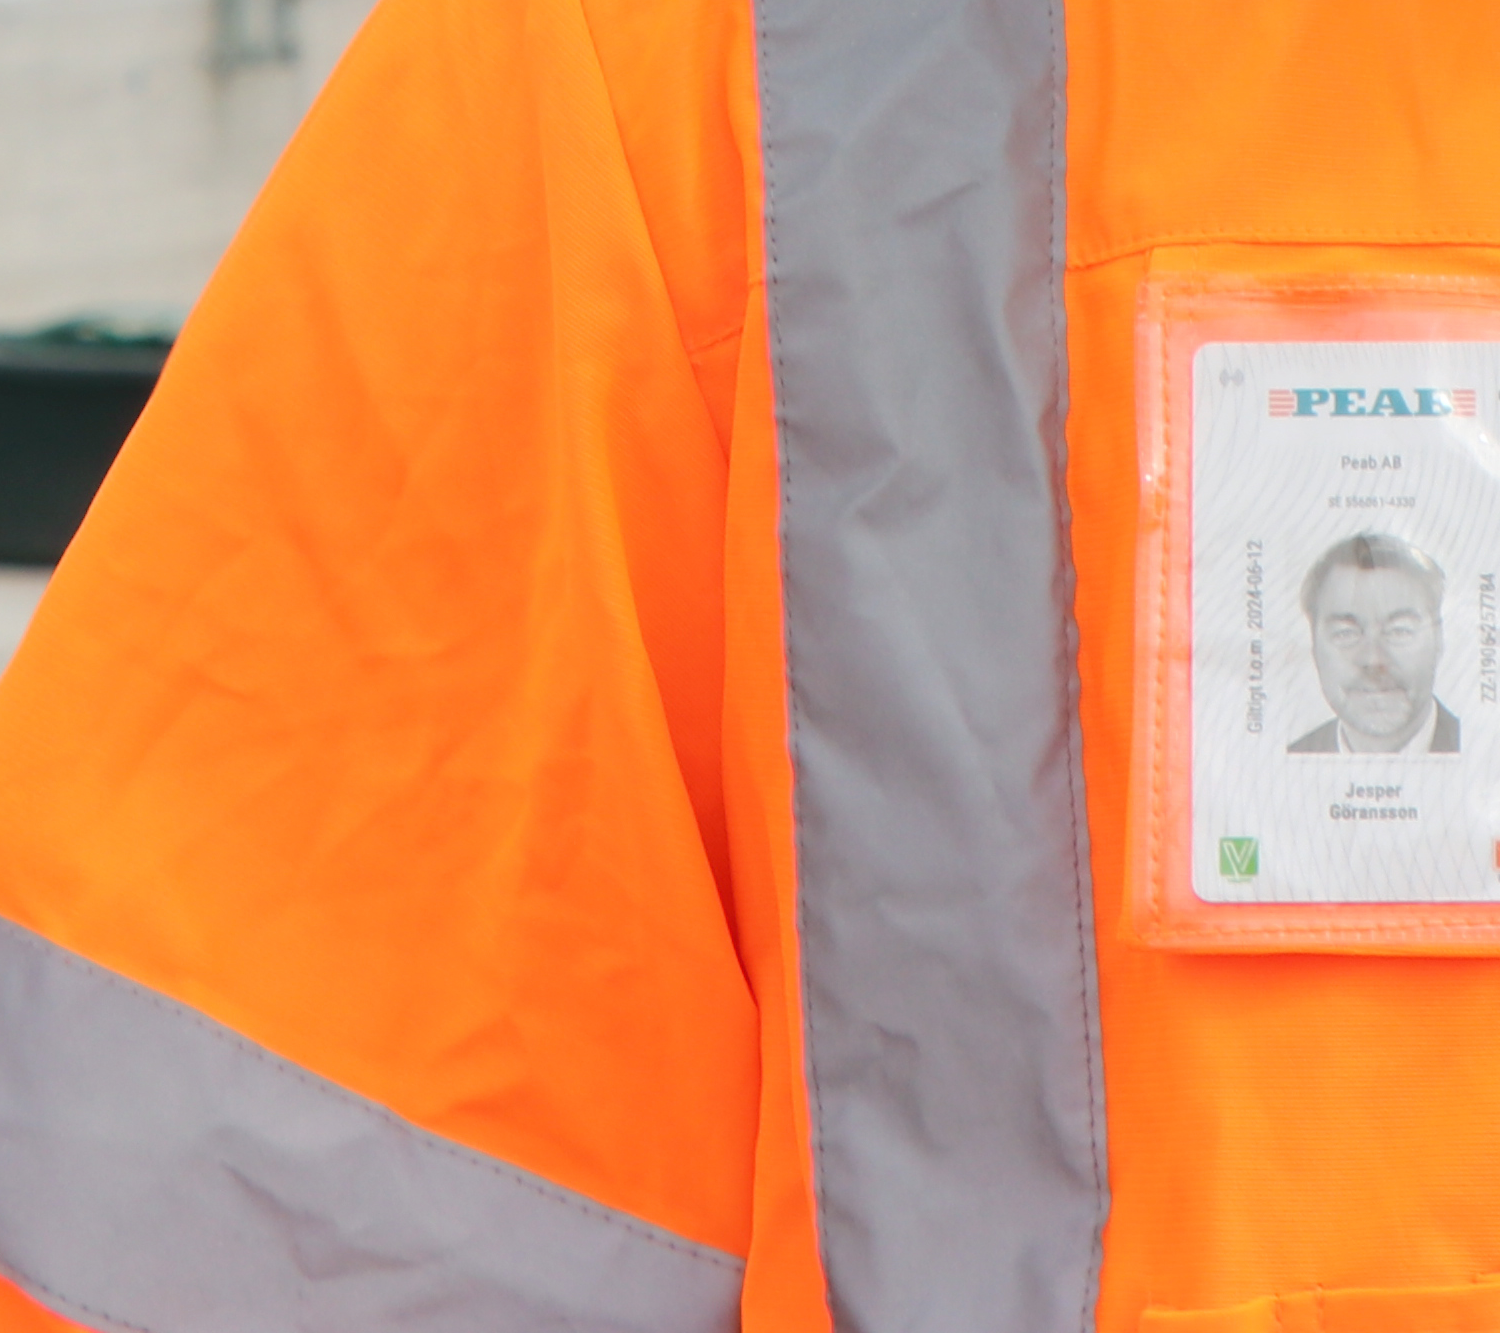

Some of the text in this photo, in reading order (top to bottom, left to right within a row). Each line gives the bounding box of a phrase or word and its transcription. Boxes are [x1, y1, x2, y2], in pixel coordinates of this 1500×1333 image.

[1341, 455, 1402, 470] Peab AB
[1248, 539, 1264, 631] 2024-06-12
[1345, 783, 1402, 802] Jesper
[1329, 803, 1418, 820] Göransson
